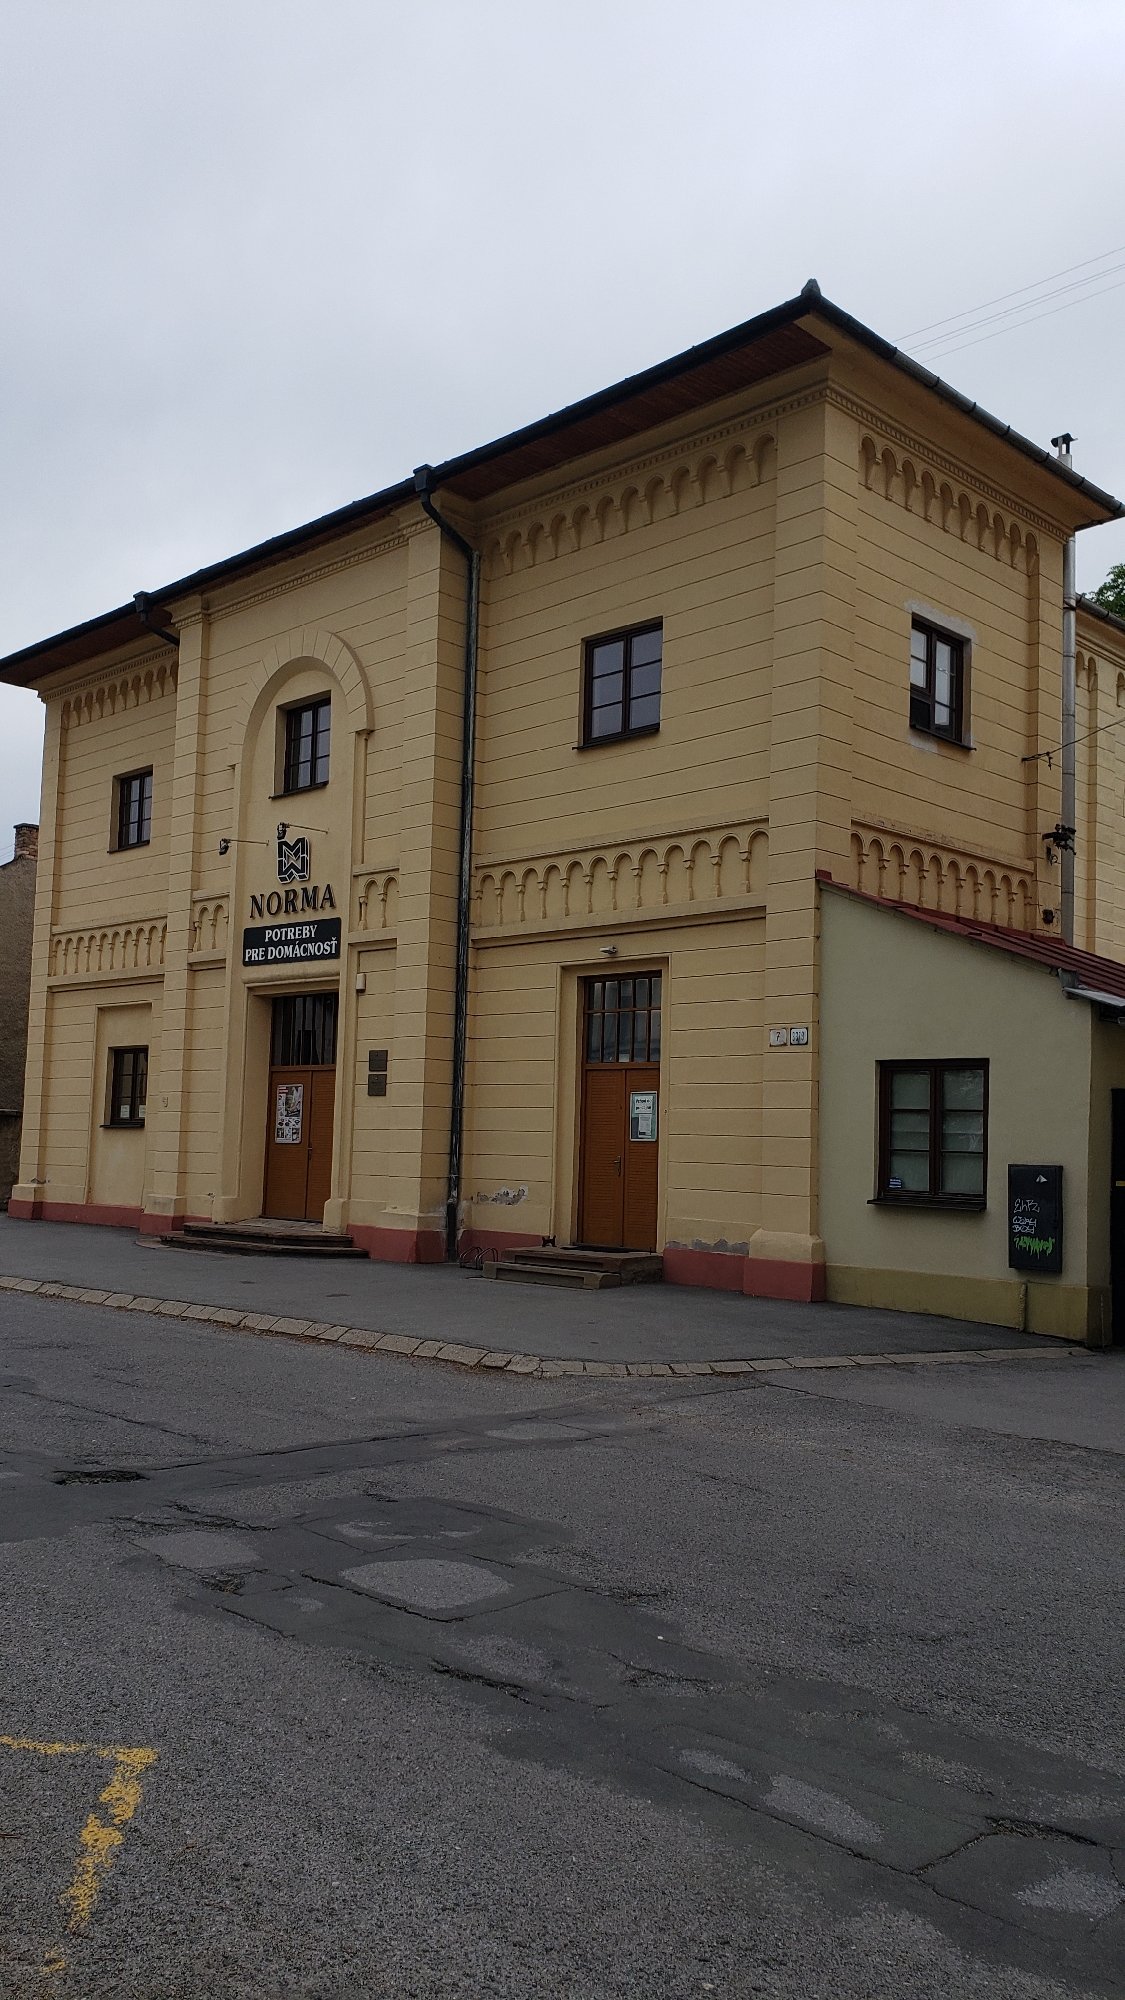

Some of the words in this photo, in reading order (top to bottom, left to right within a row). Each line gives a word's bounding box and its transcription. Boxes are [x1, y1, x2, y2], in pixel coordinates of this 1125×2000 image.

[250, 884, 336, 918] NORMA
[265, 925, 317, 942] POTREBY
[244, 947, 266, 962] PRE
[267, 937, 337, 960] DOMÁCNOSŤ
[776, 1031, 780, 1041] 7
